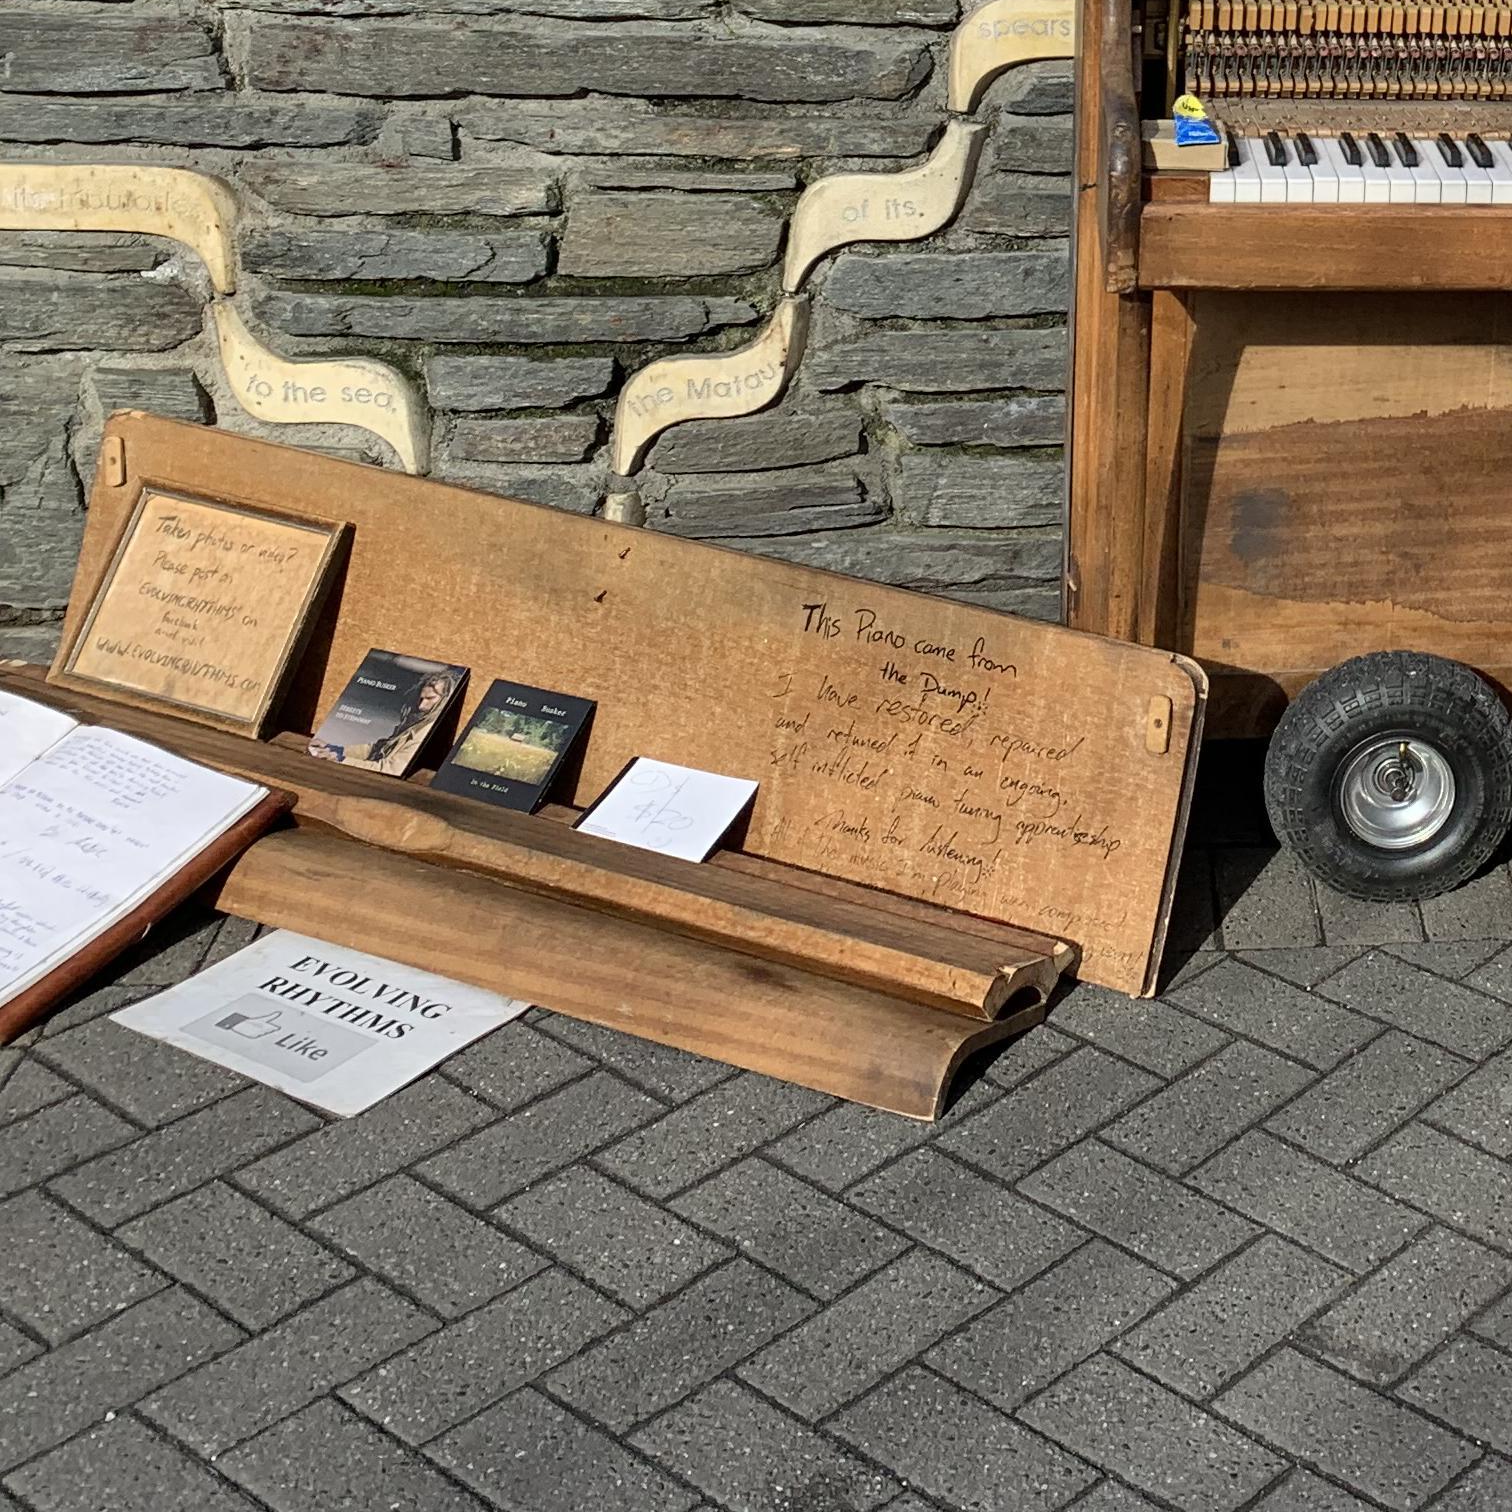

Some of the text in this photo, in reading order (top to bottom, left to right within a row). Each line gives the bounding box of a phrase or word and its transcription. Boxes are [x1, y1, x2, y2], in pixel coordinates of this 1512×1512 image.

[979, 19, 1070, 41] spears
[842, 199, 869, 222] of
[246, 375, 272, 398] to
[282, 379, 327, 403] the
[626, 386, 673, 417] the
[195, 532, 234, 552] photos
[241, 543, 254, 554] or
[152, 550, 186, 574] Please
[188, 565, 219, 585] post
[242, 615, 258, 628] on
[801, 603, 1017, 677] This Piano came from
[880, 662, 991, 714] the Dump!
[505, 696, 567, 717] Piano Busker
[772, 672, 797, 698] I
[817, 675, 860, 710] have
[990, 734, 1085, 764] repaired
[775, 714, 807, 733] and
[931, 753, 948, 771] in
[964, 764, 983, 780] an
[770, 740, 807, 768] self
[811, 746, 889, 790] inflicted
[813, 809, 871, 843] Thanks
[881, 816, 904, 845] for
[288, 955, 452, 1020] EVOLVING
[259, 976, 414, 1040] RHYTHMS
[275, 1028, 330, 1062] Like
